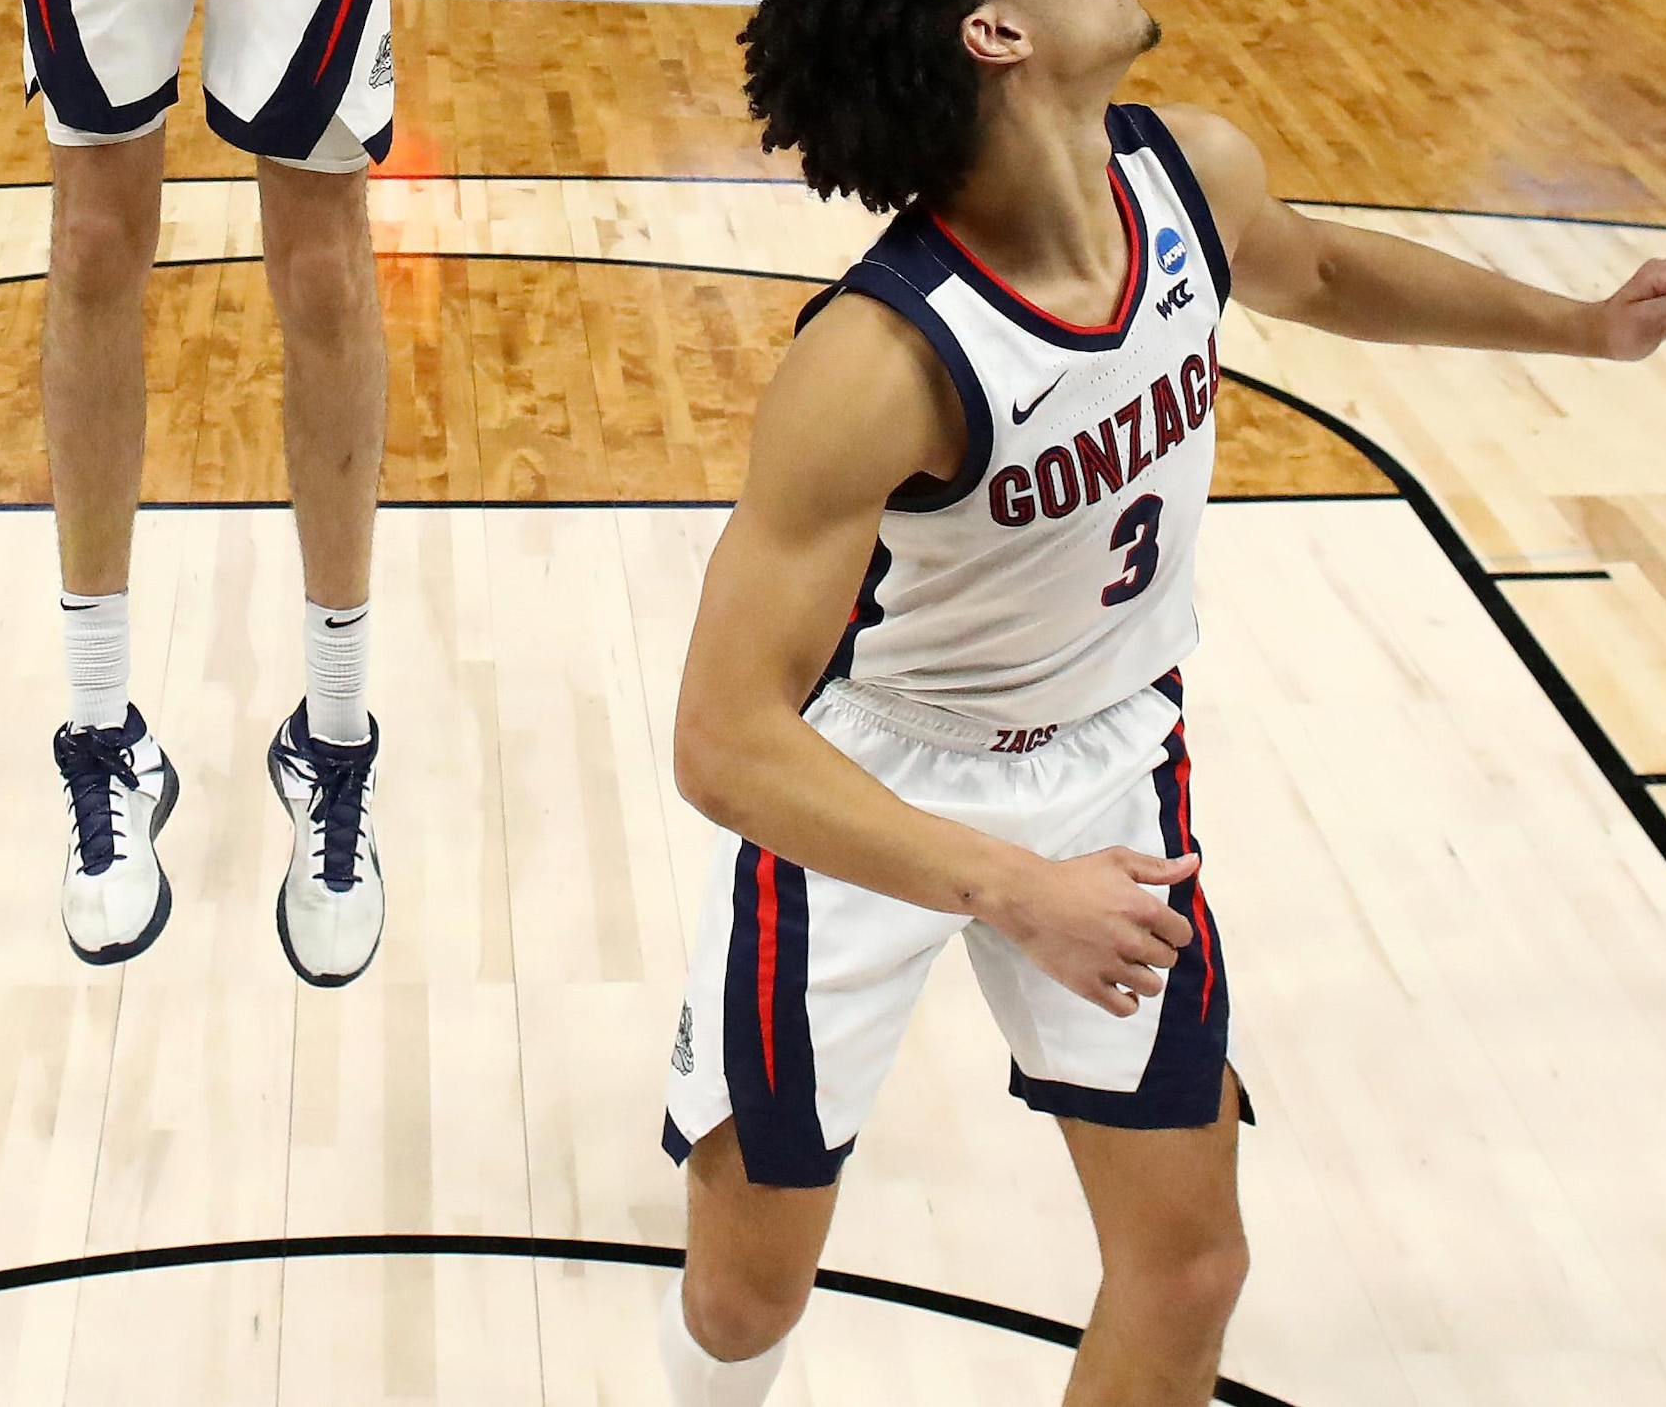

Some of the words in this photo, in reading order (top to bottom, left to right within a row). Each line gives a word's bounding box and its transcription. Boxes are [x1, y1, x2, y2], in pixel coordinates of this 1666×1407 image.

[1155, 277, 1195, 322] WCC
[1100, 492, 1165, 608] 3
[989, 723, 1058, 754] ZAGS
